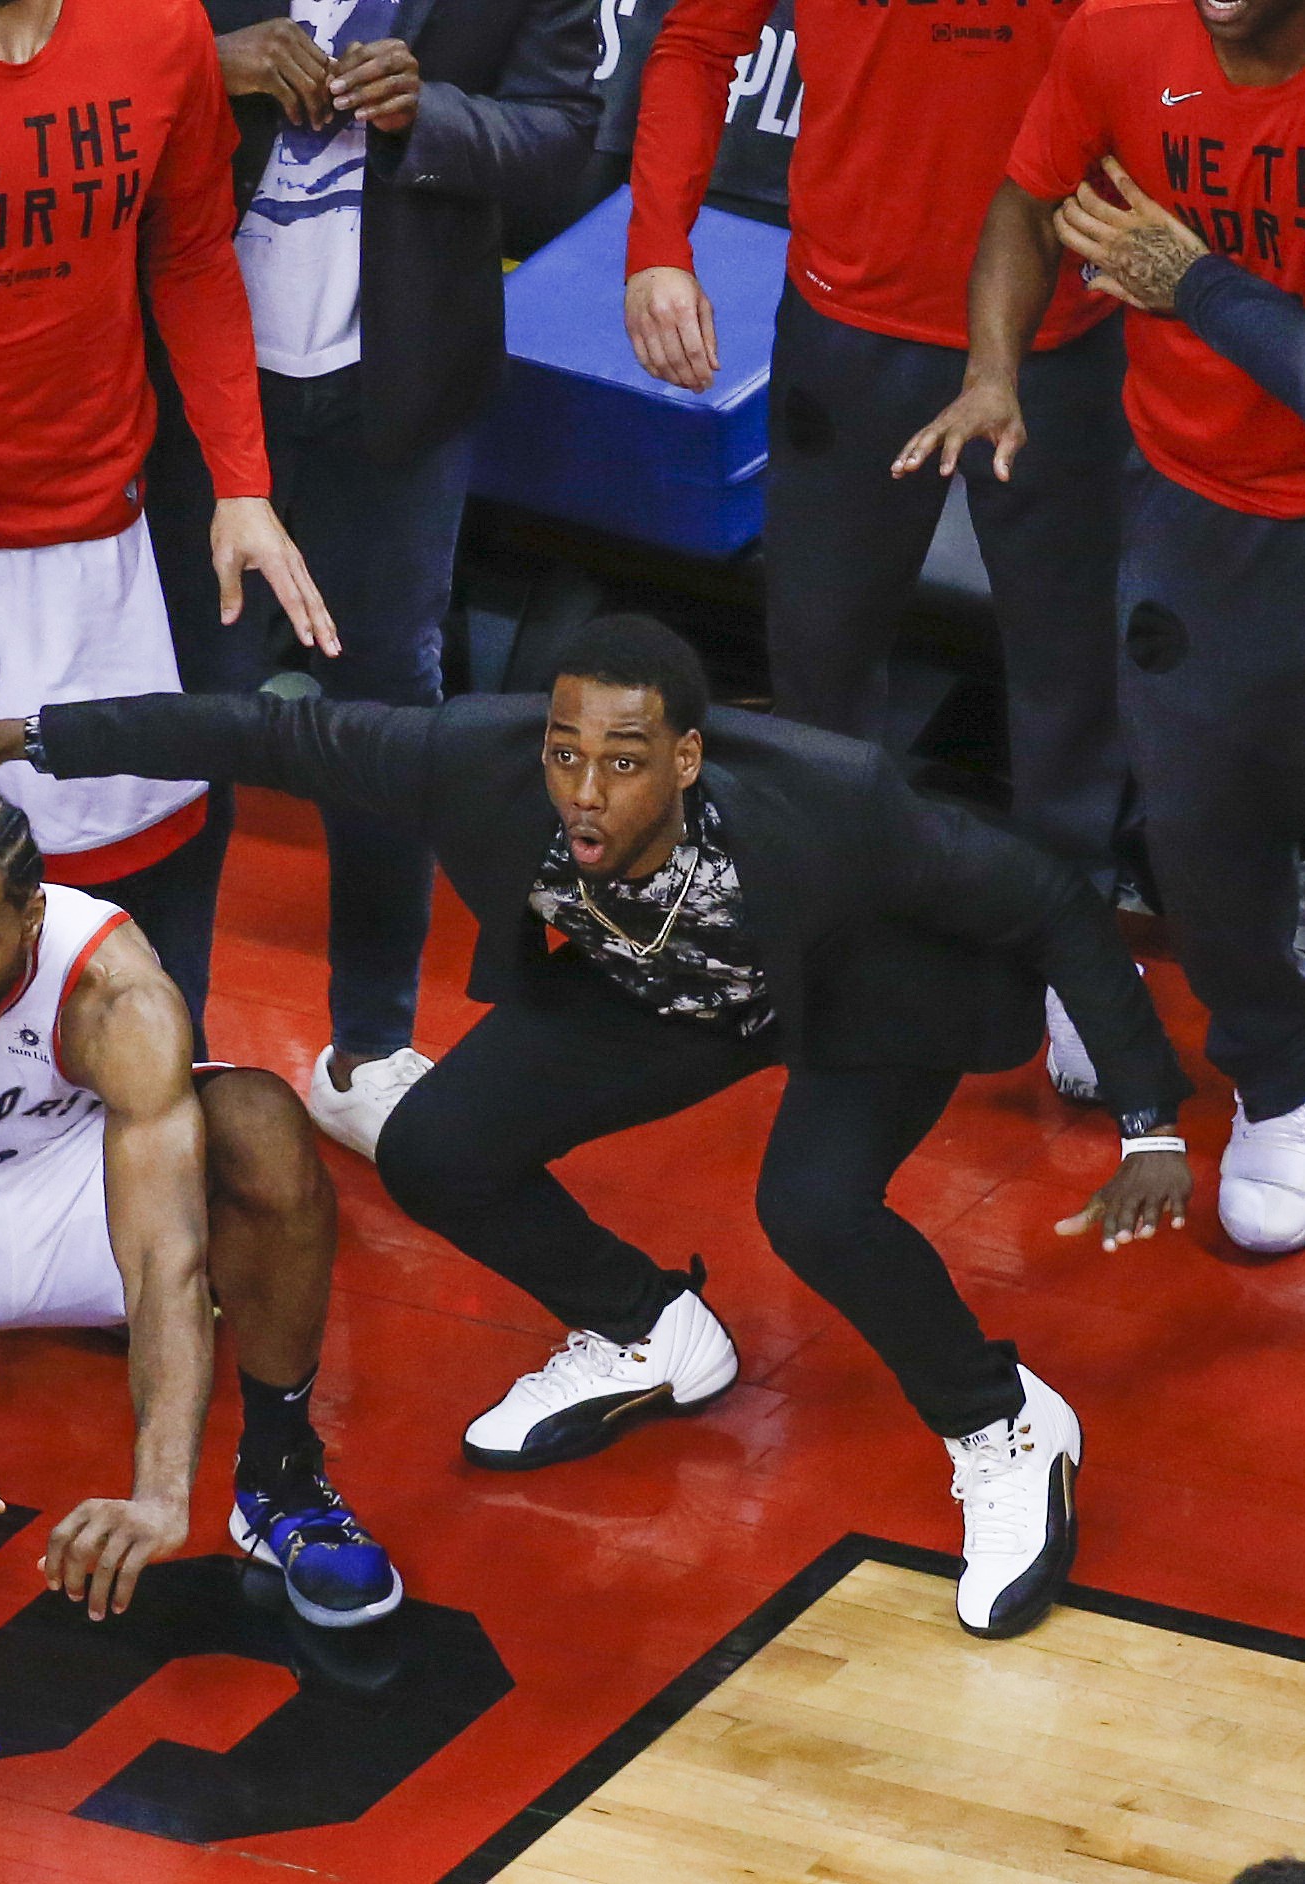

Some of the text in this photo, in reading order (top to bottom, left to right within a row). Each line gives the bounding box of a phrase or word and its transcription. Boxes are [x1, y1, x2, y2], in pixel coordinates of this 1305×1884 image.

[725, 25, 804, 138] PL
[23, 97, 137, 178] THE
[1162, 131, 1228, 196] WE
[1174, 202, 1305, 269] NOR
[7, 1046, 32, 1058] Sun
